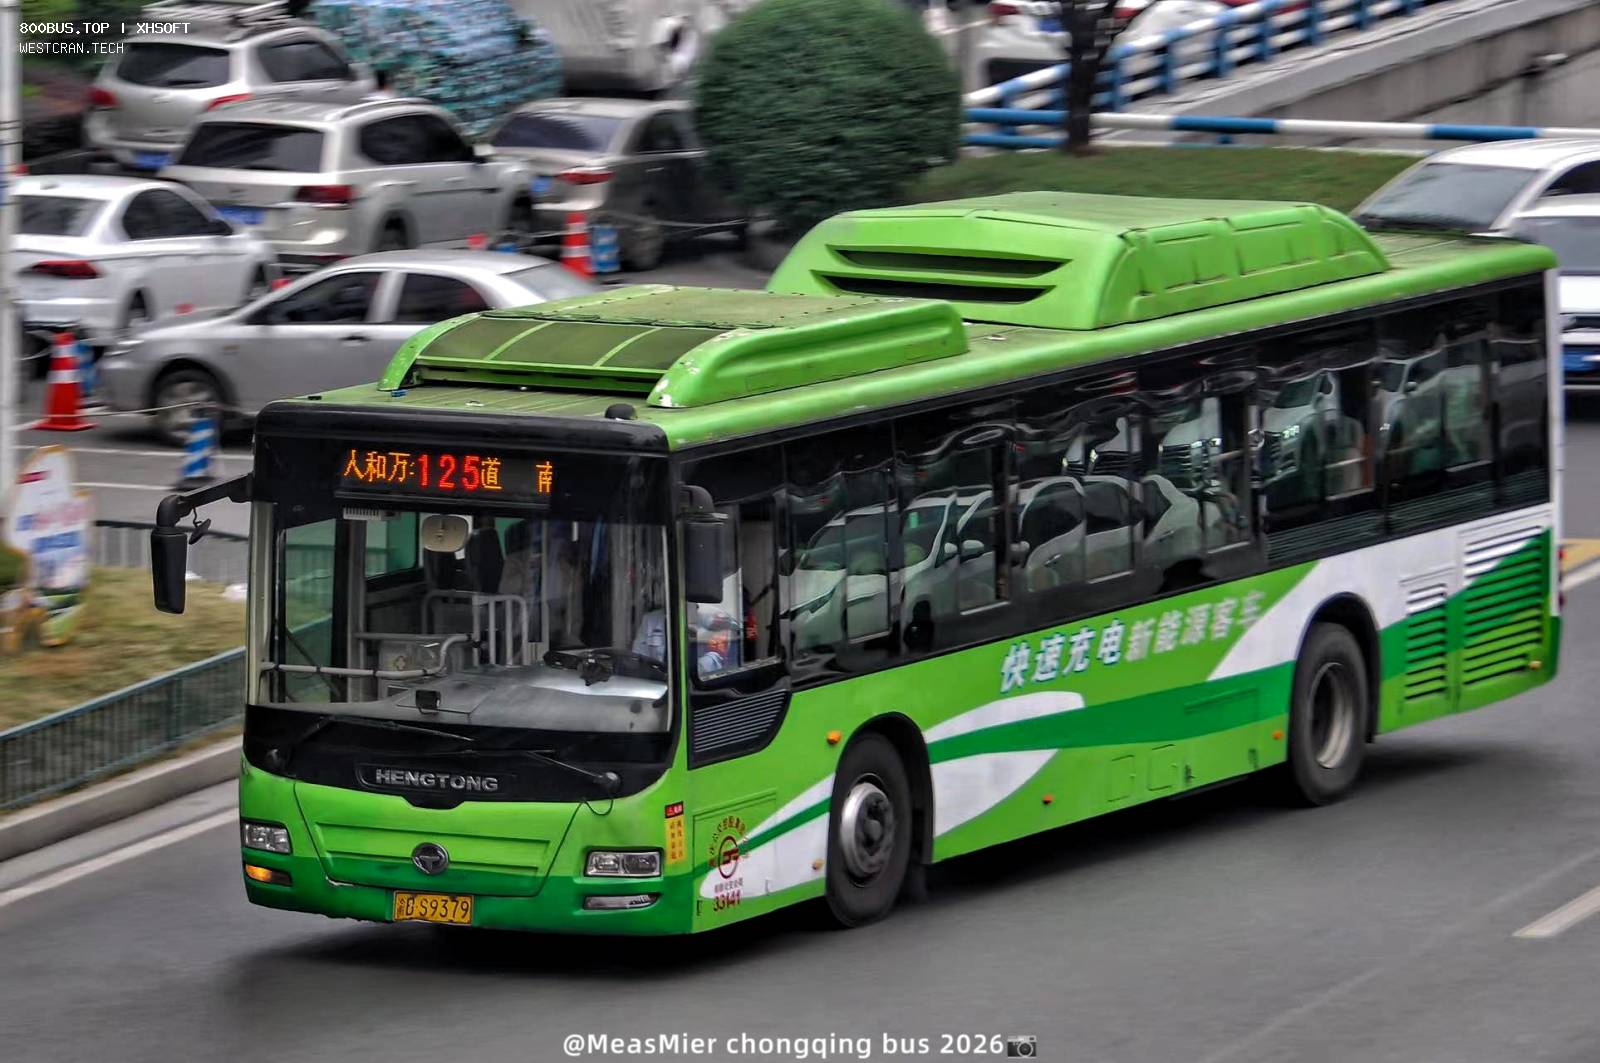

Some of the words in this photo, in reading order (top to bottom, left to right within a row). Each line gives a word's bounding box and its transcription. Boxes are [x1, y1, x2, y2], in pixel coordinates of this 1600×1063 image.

[343, 449, 415, 483] 人和万
[418, 454, 480, 490] 125
[375, 768, 499, 792] HENGTONG
